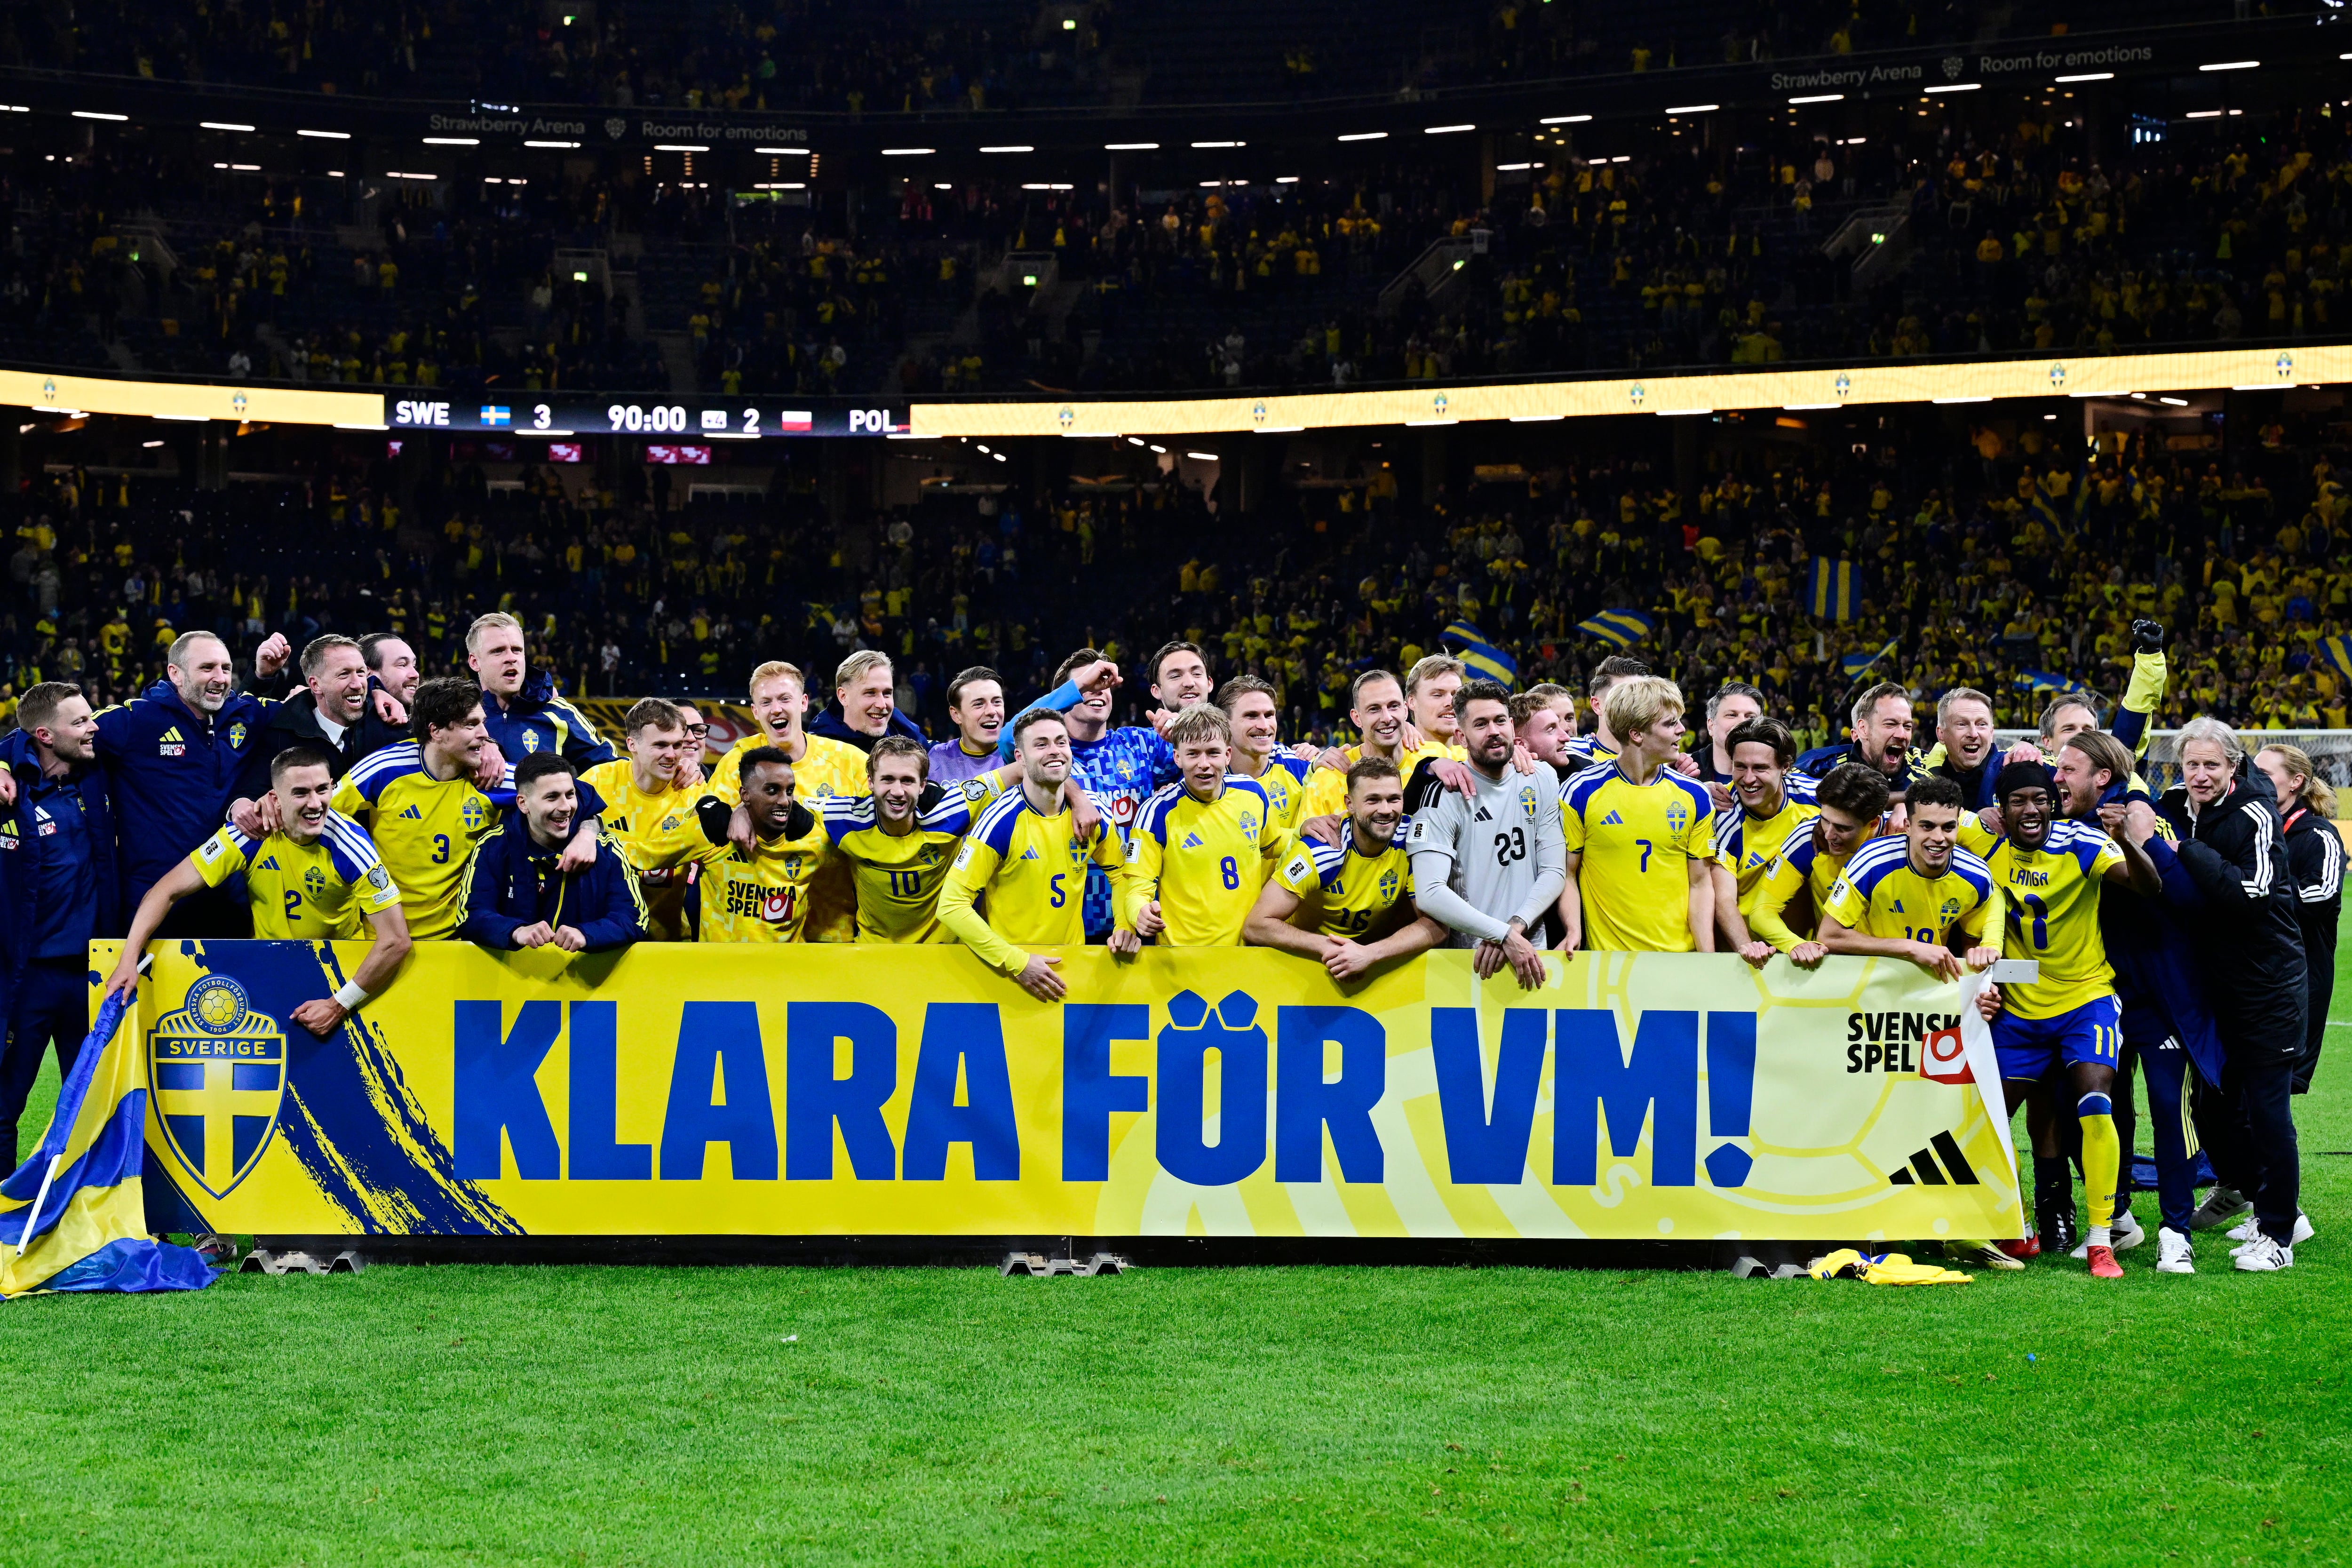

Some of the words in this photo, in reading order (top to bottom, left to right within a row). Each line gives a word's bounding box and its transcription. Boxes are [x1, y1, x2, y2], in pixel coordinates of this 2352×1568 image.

[1979, 56, 2032, 73] Room
[2036, 51, 2063, 68] for
[2065, 45, 2152, 67] emotions
[1771, 71, 1867, 90] Strawberry
[1870, 65, 1923, 82] Arena
[430, 114, 528, 135] Strawberry
[532, 117, 586, 134] Arena
[643, 121, 694, 137] Room
[697, 123, 724, 138] for
[725, 126, 808, 142] emotions
[396, 400, 450, 425] SWE
[533, 404, 551, 429] 3
[608, 405, 686, 431] 90:00
[743, 408, 760, 433] 2
[849, 409, 898, 432] POL
[38, 821, 56, 830] ENSKA
[432, 833, 450, 864] 3
[1494, 827, 1526, 867] 23
[1636, 839, 1652, 873] 7
[2014, 854, 2033, 864] SVERIGE
[1220, 856, 1240, 890] 8
[2009, 868, 2049, 887] LANGA
[285, 890, 302, 920] 2
[727, 880, 797, 901] SVENSKA
[1050, 873, 1065, 908] 5
[727, 897, 761, 918] SPEL
[191, 993, 204, 1026] SVENSKA
[199, 980, 245, 1026] FOTBOLLFÖRBUNDET
[1847, 1012, 1961, 1042] SVENSK
[2093, 1024, 2114, 1058] 11
[169, 1041, 266, 1056] SVERIGE
[1847, 1043, 1915, 1073] SPEL
[453, 1001, 1020, 1181] KLARA
[1062, 990, 1386, 1186] FÖR
[1431, 1008, 1757, 1188] VM!
